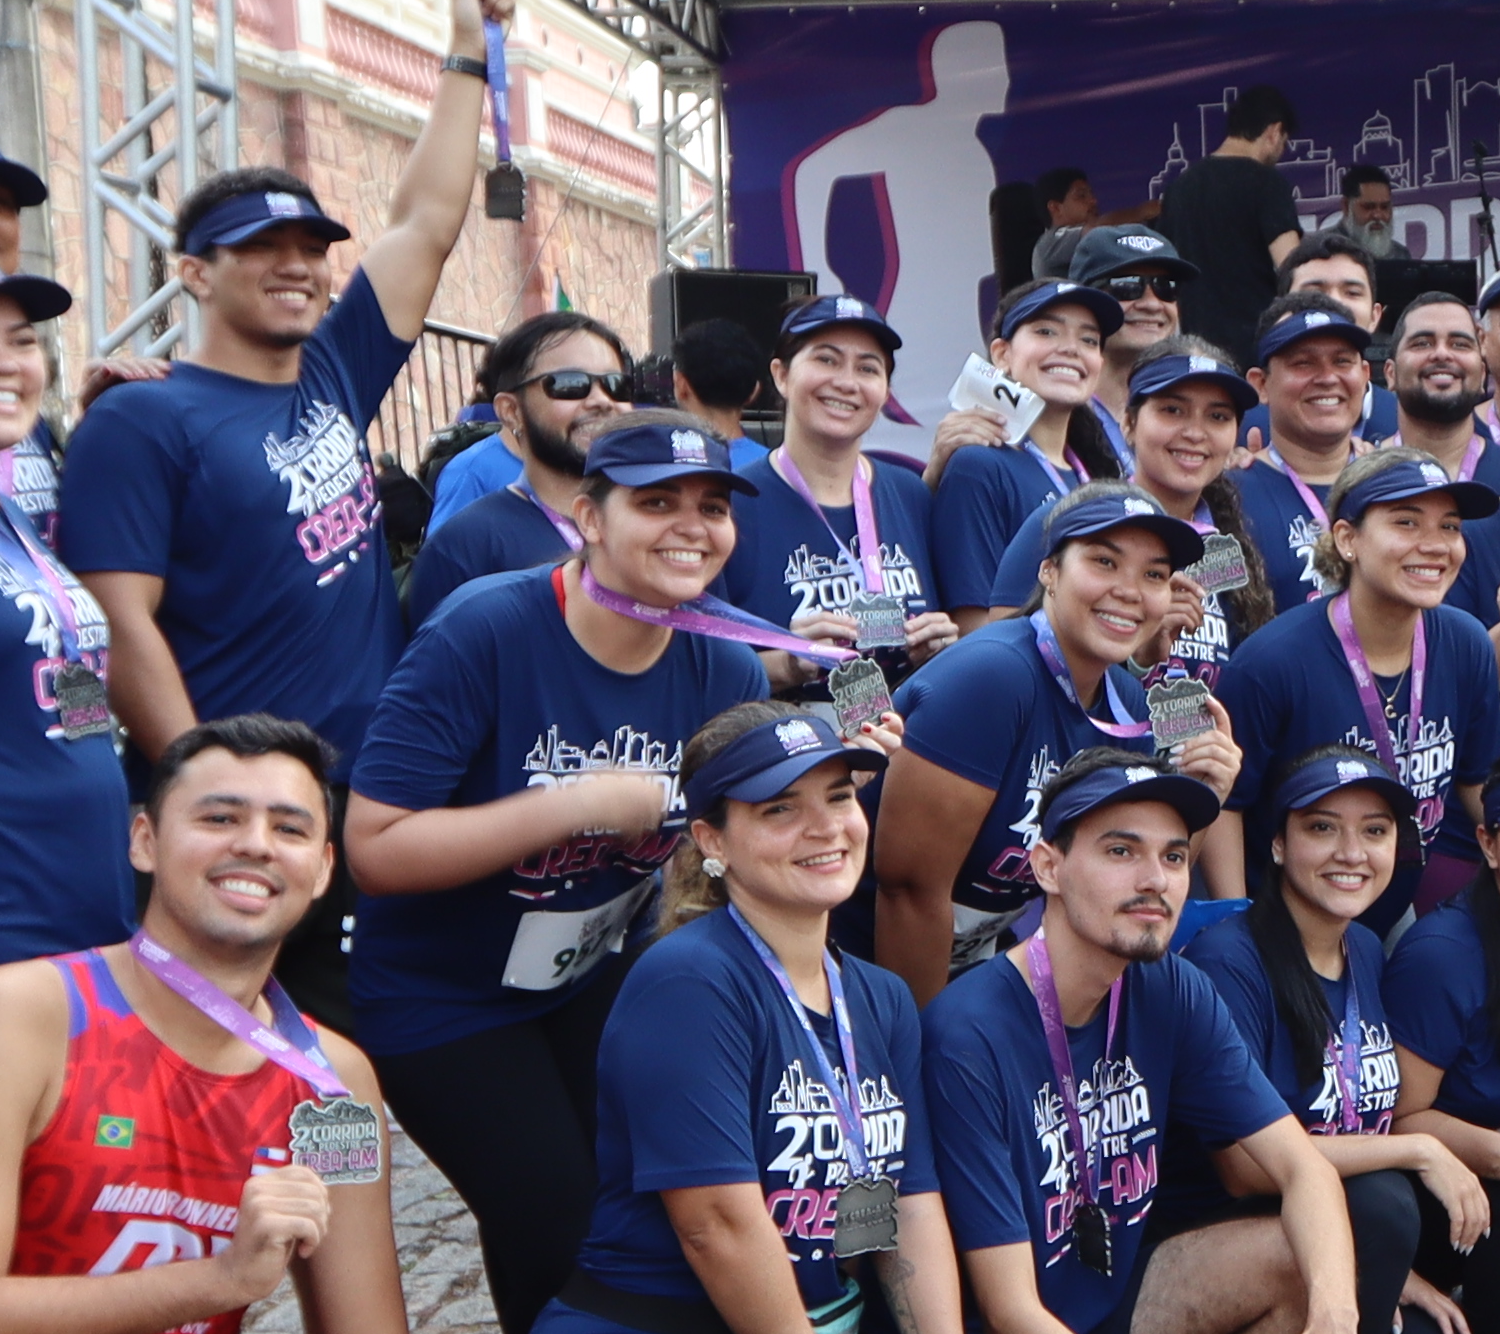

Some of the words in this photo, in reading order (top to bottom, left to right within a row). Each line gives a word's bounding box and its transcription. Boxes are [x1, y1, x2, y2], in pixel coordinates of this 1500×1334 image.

[845, 673, 883, 698] CORRIDA
[313, 1121, 376, 1142] CORRIDA
[318, 1141, 362, 1150] PEDESTRE
[299, 1148, 379, 1173] CREA-AM
[92, 1181, 169, 1217] MÁRIO
